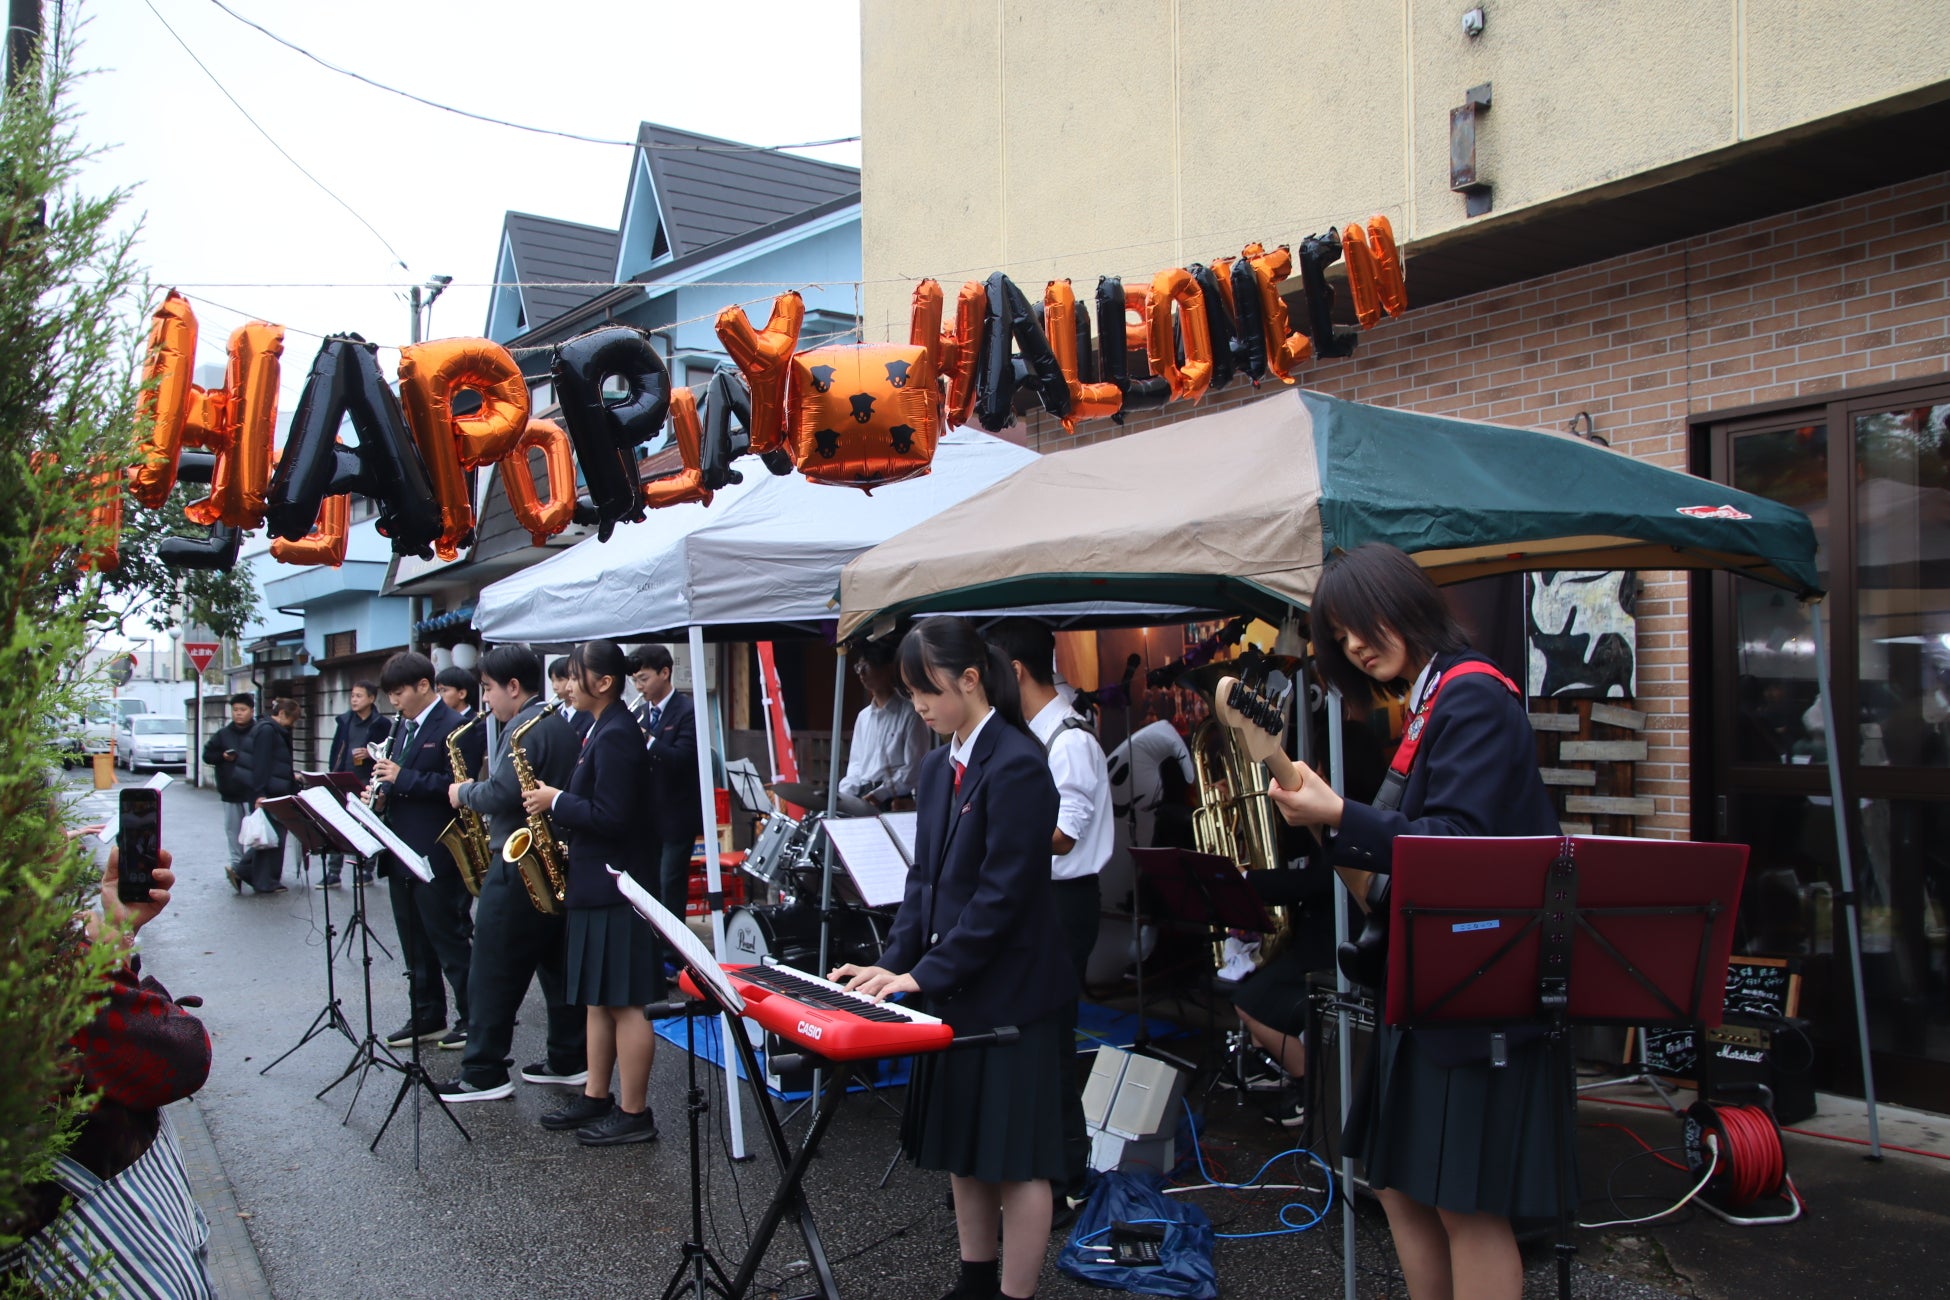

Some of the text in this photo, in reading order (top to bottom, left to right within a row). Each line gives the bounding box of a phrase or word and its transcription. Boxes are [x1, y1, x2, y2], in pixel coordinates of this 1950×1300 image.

[128, 288, 805, 562] HAPPY
[736, 928, 756, 951] Pearl
[797, 1020, 823, 1040] CASIO
[1716, 1045, 1765, 1063] Marshall
